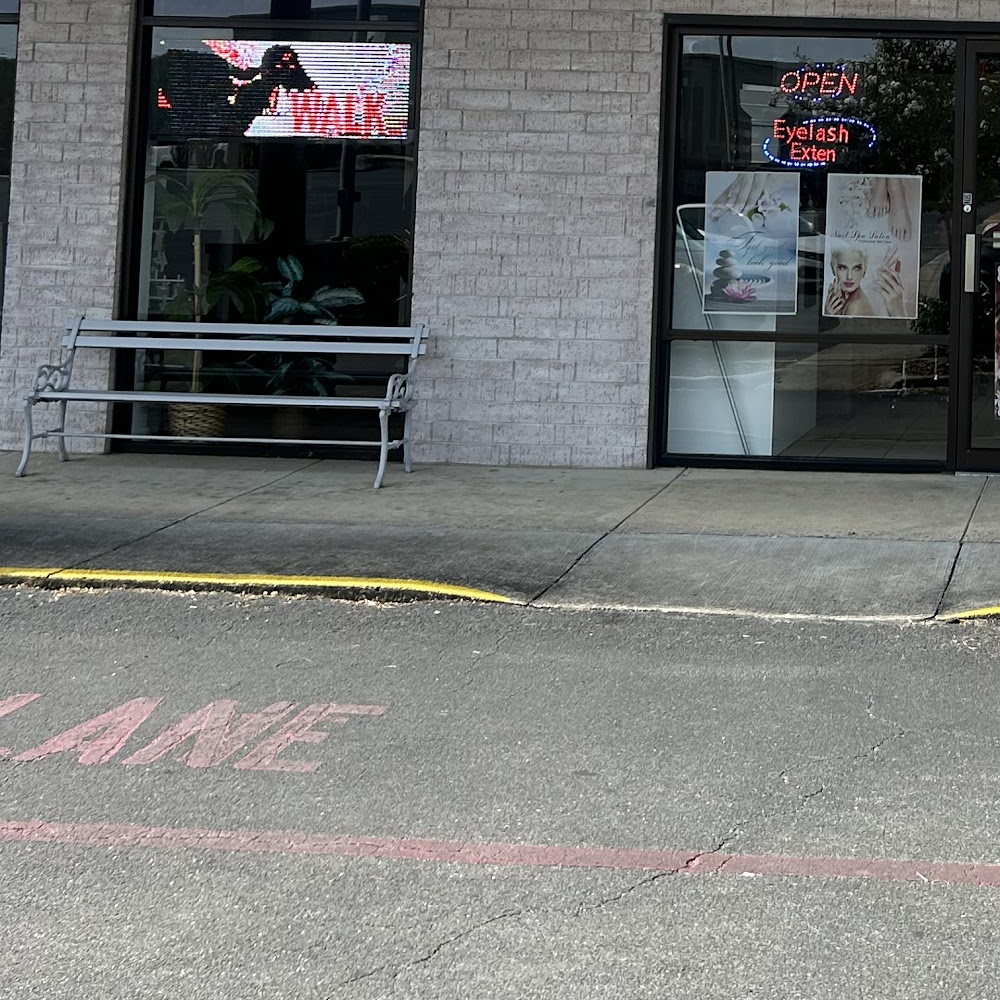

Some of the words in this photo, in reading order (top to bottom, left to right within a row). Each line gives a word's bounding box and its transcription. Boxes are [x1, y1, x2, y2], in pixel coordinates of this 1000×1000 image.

[780, 71, 860, 96] OPEN
[773, 119, 849, 145] Eyelash
[790, 142, 837, 163] Exten
[763, 257, 793, 273] good
